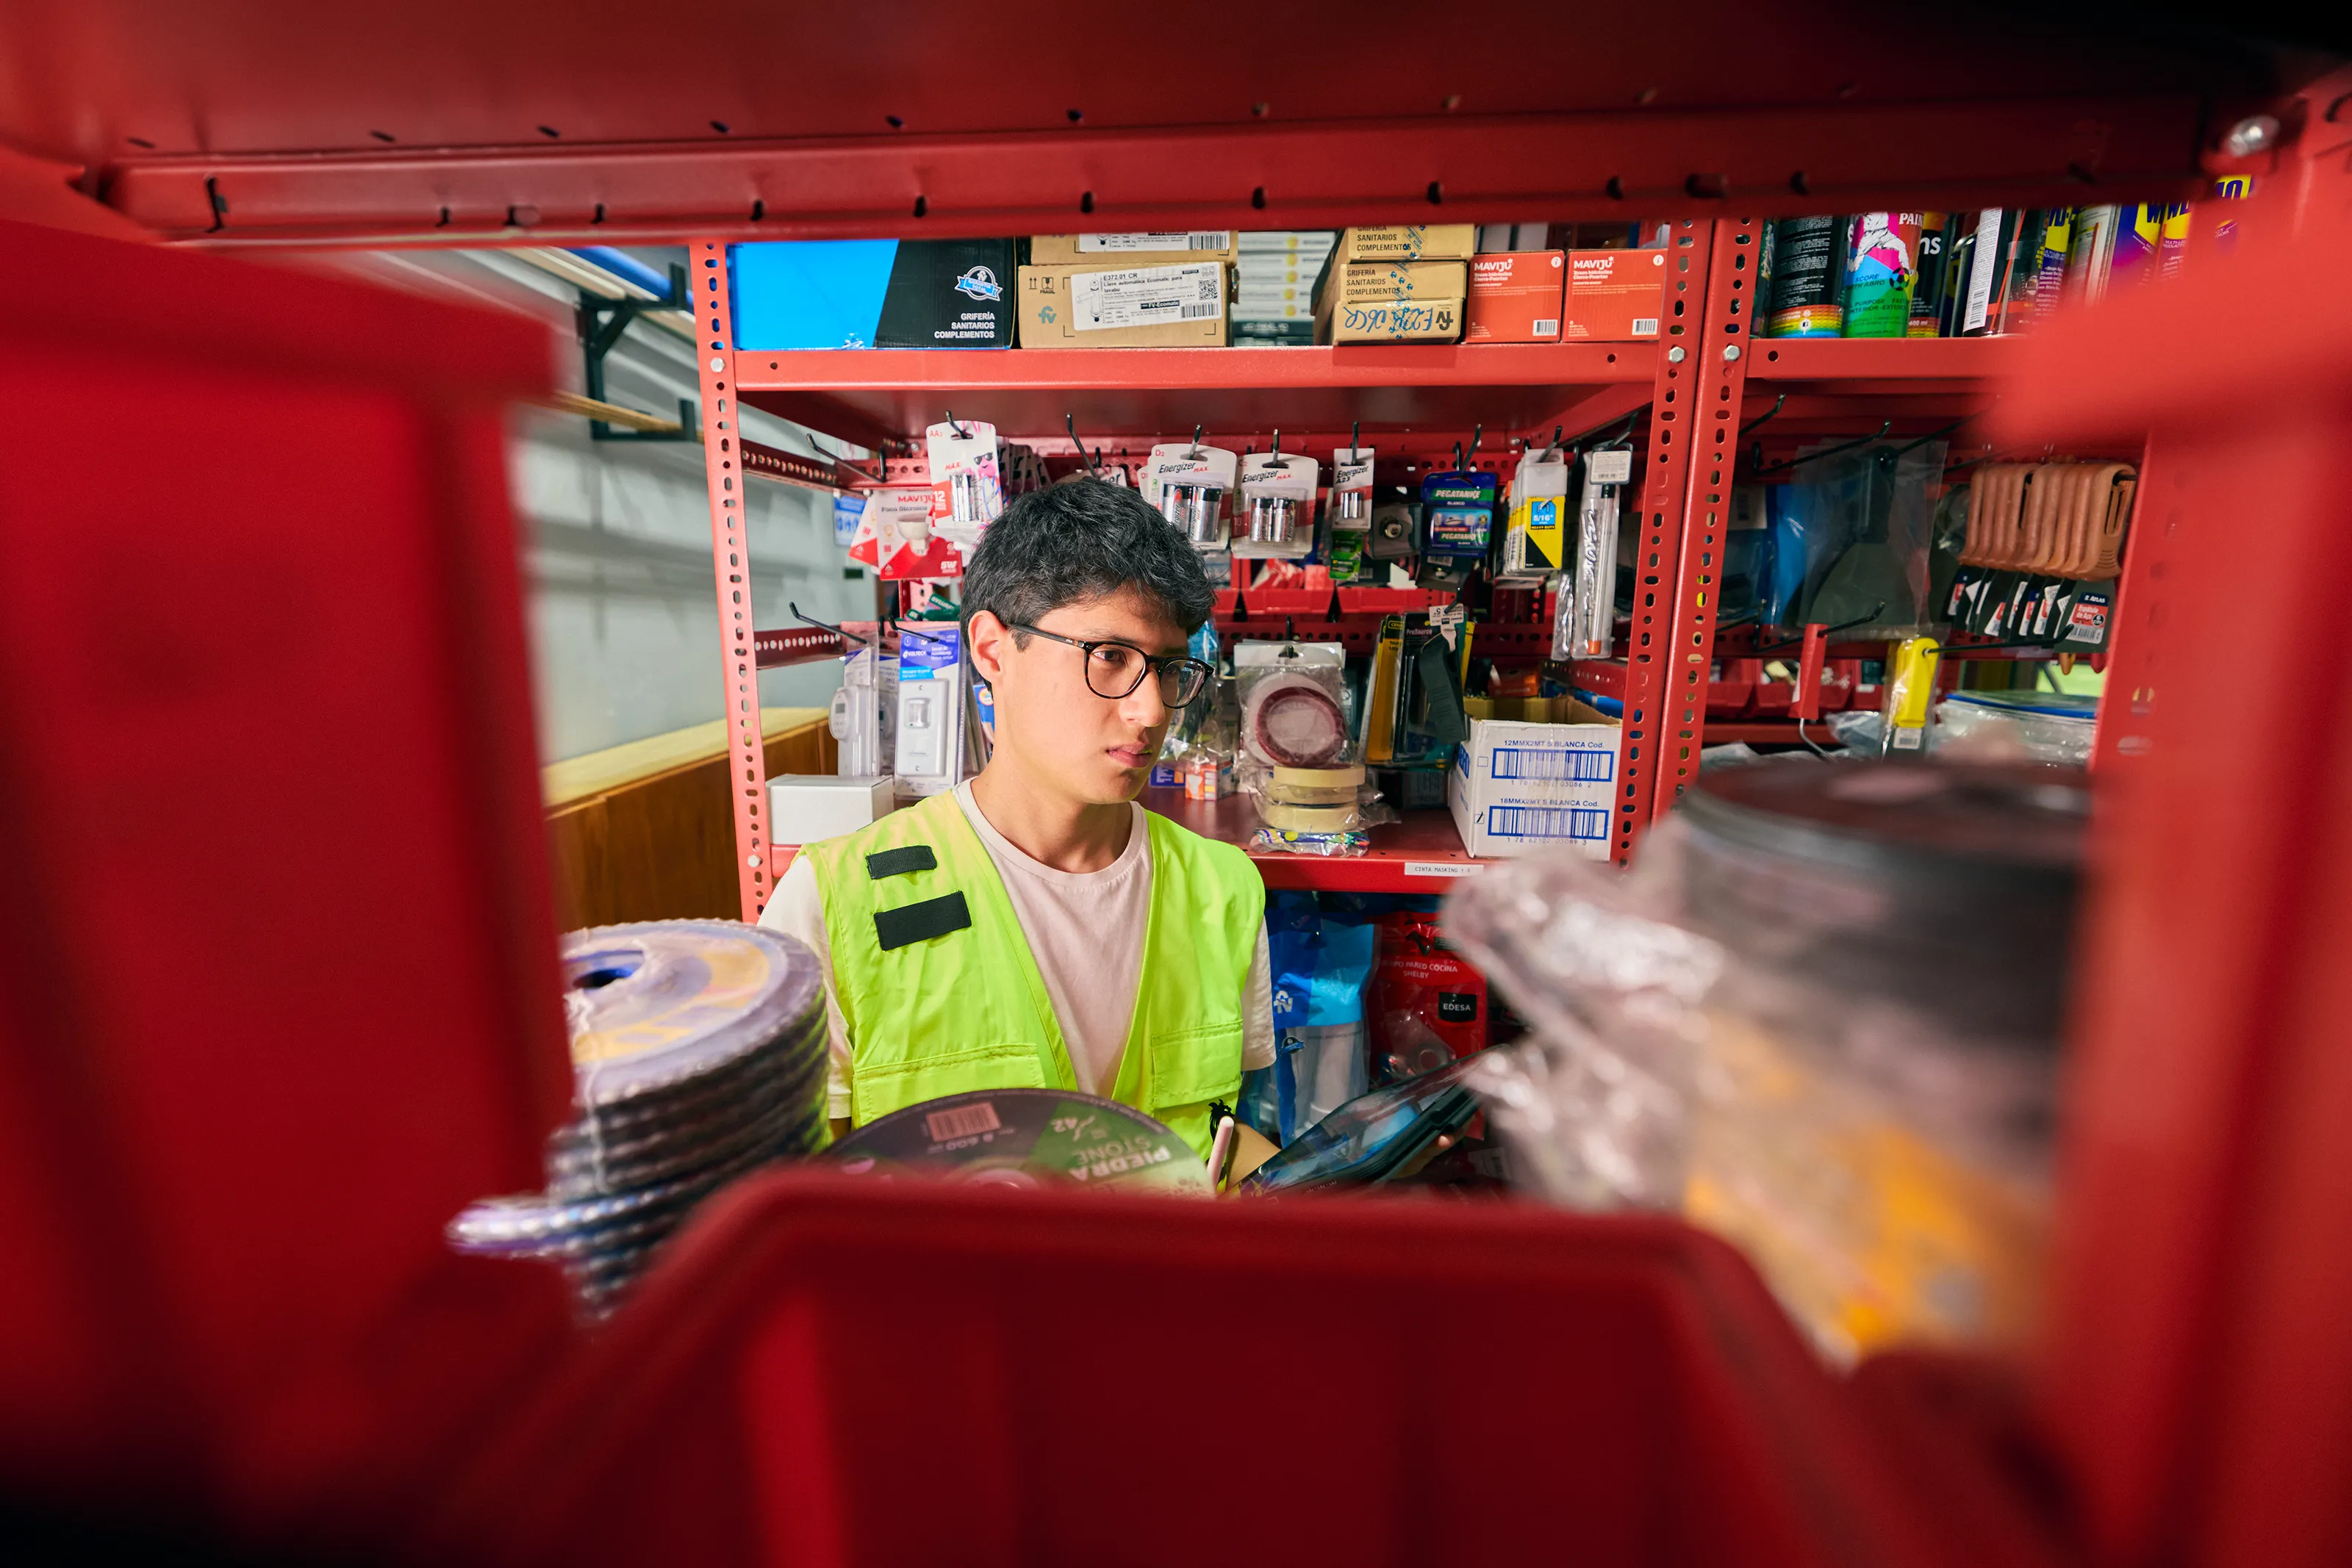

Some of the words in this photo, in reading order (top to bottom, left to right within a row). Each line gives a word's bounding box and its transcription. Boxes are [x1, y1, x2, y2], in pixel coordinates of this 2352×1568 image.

[1357, 243, 1411, 251] COMPLEMENTOS
[1474, 261, 1512, 273] MAVIJU
[1574, 259, 1613, 270] MAVIJU
[1347, 267, 1376, 276] GRIFERÍA
[1347, 278, 1386, 286] SANITARIOS
[1855, 273, 1879, 283] SCORE
[1347, 287, 1400, 295] COMPLEMENTOS
[961, 311, 996, 320] GRIFERÍA
[951, 322, 995, 330] SANITARIOS
[934, 331, 995, 339] COMPLEMENTOS
[944, 461, 961, 471] MAX
[1158, 461, 1196, 473] Energizer
[1241, 470, 1279, 483] Energizer
[1337, 466, 1369, 478] Energizer
[933, 490, 946, 502] 12
[1435, 489, 1481, 499] PEGATANKE
[1405, 961, 1427, 970] PARED
[1429, 963, 1458, 973] COCINA
[1403, 970, 1430, 979] SHELBY
[1443, 1003, 1471, 1011] EDESA
[1077, 1135, 1151, 1165] STONE
[1069, 1145, 1171, 1182] PIEDRA
